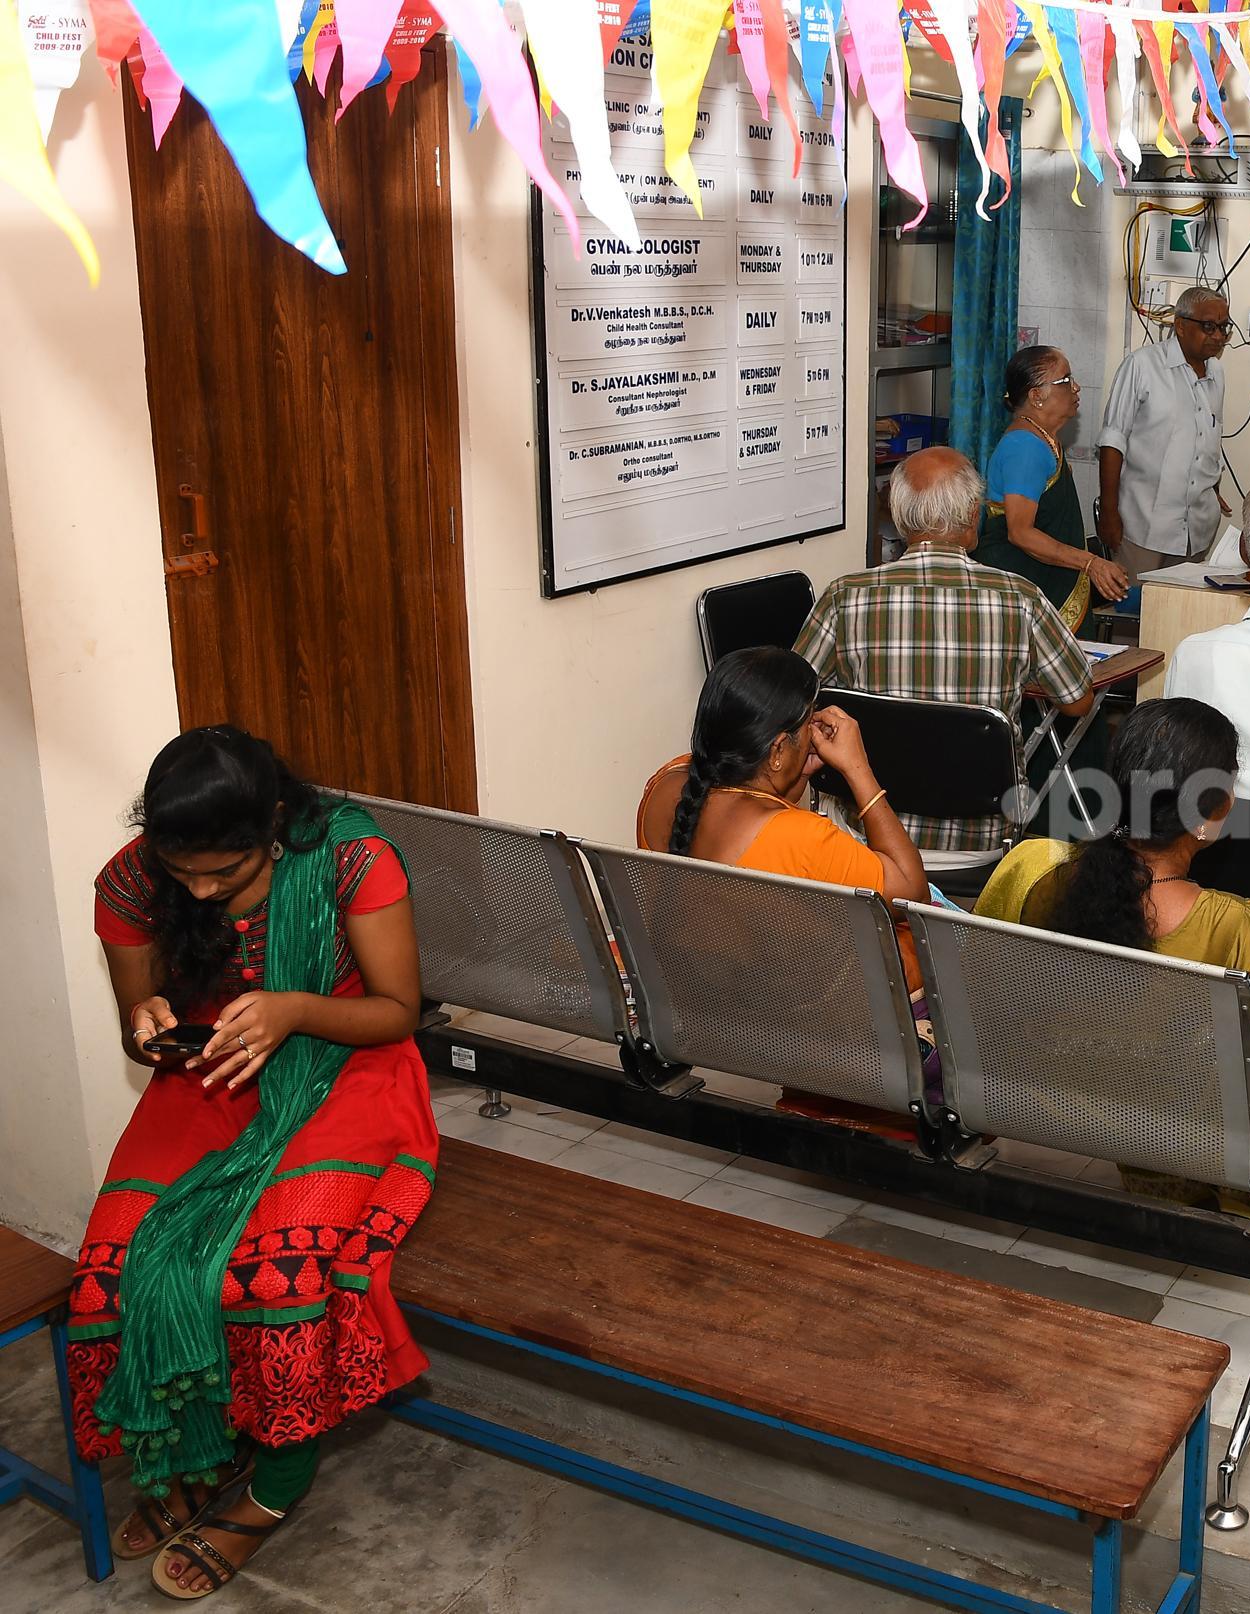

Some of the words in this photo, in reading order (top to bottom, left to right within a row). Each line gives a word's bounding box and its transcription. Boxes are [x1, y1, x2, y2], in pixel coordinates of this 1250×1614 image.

[59, 17, 87, 28] SYMA
[412, 17, 432, 26] SYMA
[62, 33, 82, 41] FEST
[34, 43, 82, 51] 2009-2010
[749, 125, 773, 141] DAILY
[750, 189, 774, 204] DAILY
[802, 191, 807, 205] 4
[740, 245, 773, 257] MONDAY
[775, 245, 781, 257] &
[801, 252, 811, 267] 10
[816, 252, 826, 266] 12
[624, 263, 642, 278] நல
[740, 261, 782, 273] THURSDAY
[571, 305, 651, 322] Dr.V.Venkatesh
[691, 305, 714, 316] D.C.H.
[746, 311, 777, 329] DAILY
[606, 323, 625, 333] Child
[626, 322, 648, 332] Health
[649, 321, 684, 331] Consultant
[740, 366, 782, 381] WEDNESDAY
[807, 369, 812, 382] 5
[571, 380, 588, 394] Dr.
[590, 371, 679, 392] S.JAYALAKSHMI
[702, 370, 717, 381] D.M
[745, 385, 751, 396] &
[752, 382, 777, 395] FRIDAY
[608, 392, 645, 404] Consultant
[646, 387, 688, 401] Nephrologist
[742, 425, 778, 442] THURSDAY
[806, 427, 811, 440] 5
[569, 450, 580, 461] Dr.
[739, 447, 745, 458] &
[746, 440, 782, 457] SATURDAY
[623, 457, 641, 467] Ortho
[641, 451, 674, 465] consultant
